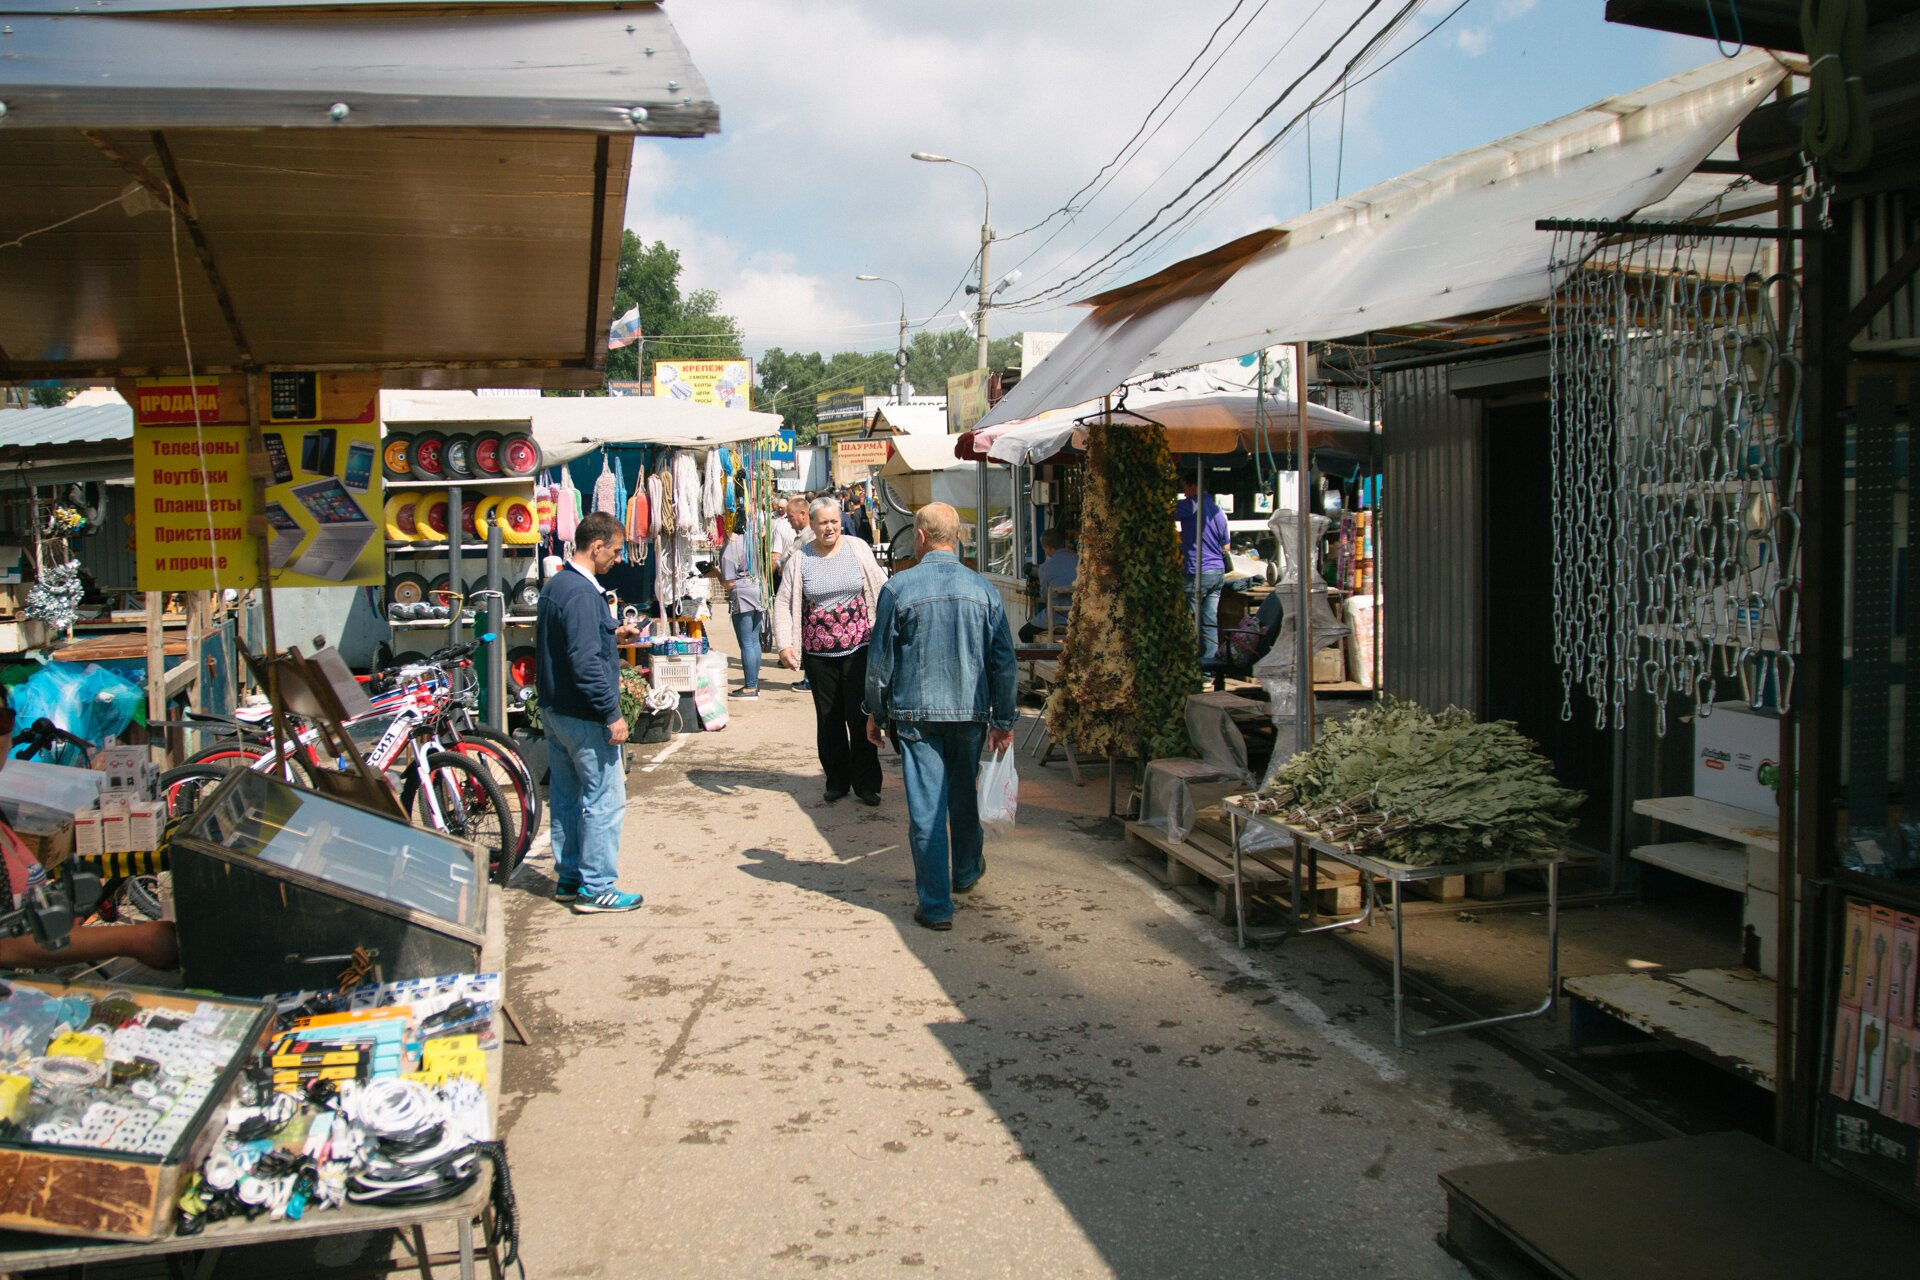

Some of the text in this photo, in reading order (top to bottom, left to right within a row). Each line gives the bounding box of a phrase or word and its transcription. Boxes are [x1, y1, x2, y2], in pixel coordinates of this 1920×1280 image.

[682, 364, 724, 372] КРЕПЕЖ
[141, 394, 218, 413] ПРОДАЖА
[152, 440, 240, 457] Телефоны
[841, 442, 883, 450] ШАУРМА
[153, 468, 228, 485] Ноутбуки
[154, 498, 242, 513] Планшеты
[155, 526, 242, 543] Приставки
[156, 556, 228, 572] и прочее
